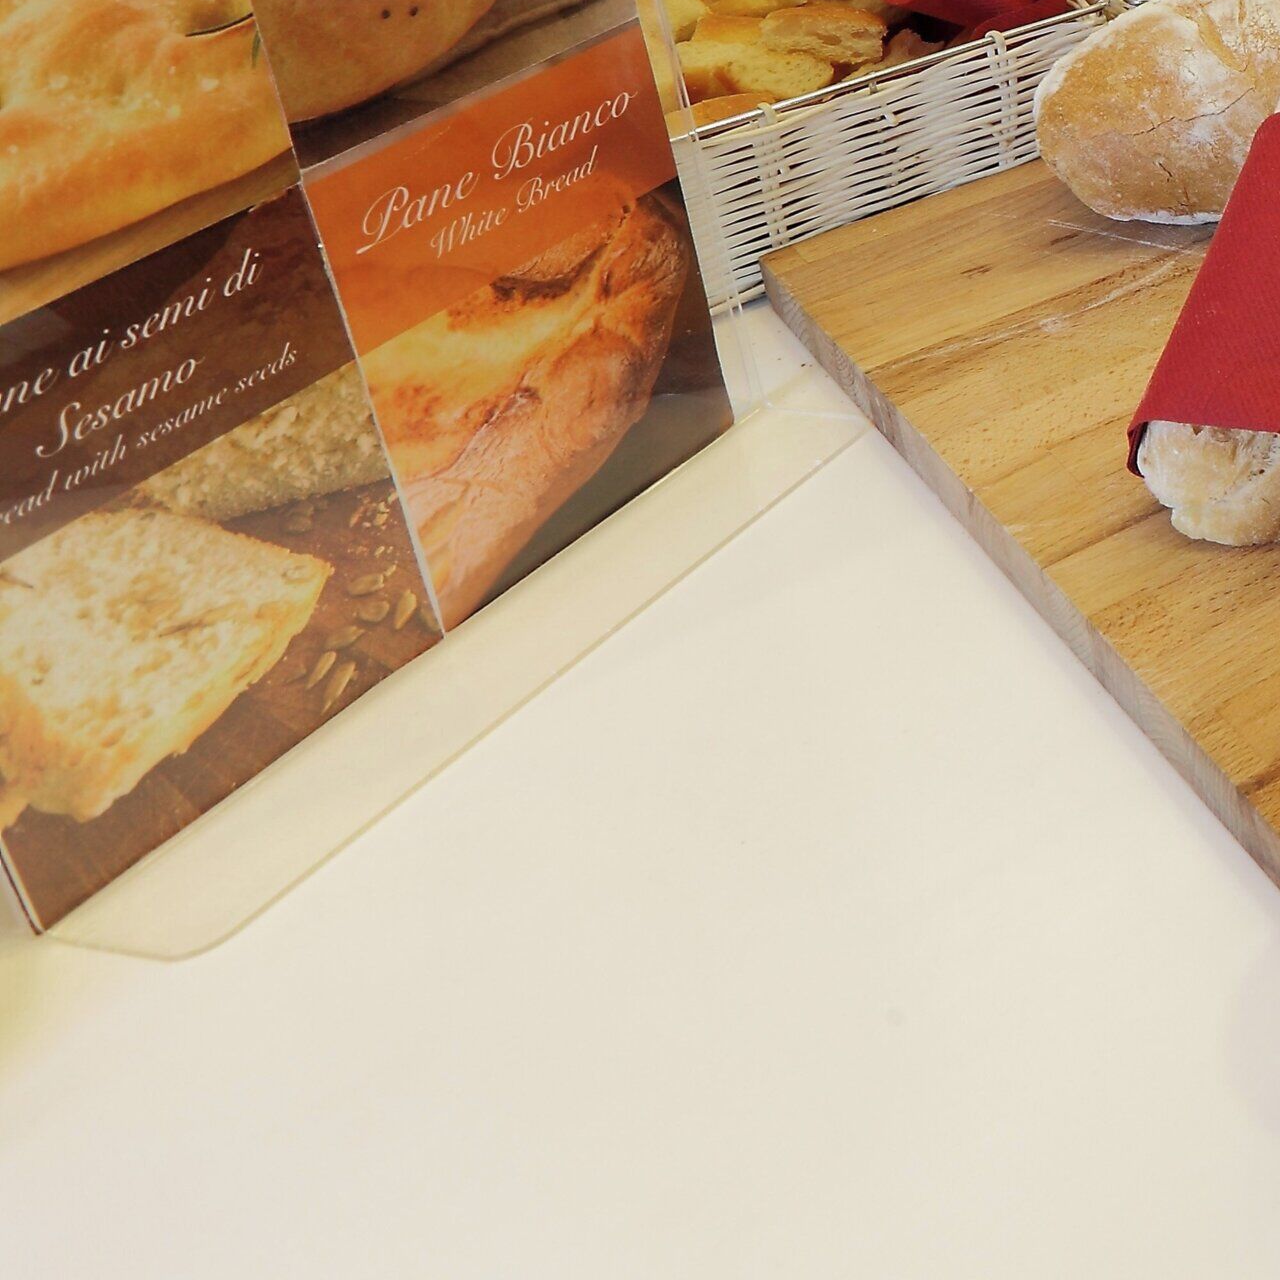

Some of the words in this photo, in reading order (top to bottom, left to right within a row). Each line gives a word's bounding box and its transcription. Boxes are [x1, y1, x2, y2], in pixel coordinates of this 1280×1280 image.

[356, 171, 480, 255] Pane
[492, 91, 638, 180] Bianco
[430, 207, 506, 258] White
[516, 145, 598, 213] Bread
[0, 368, 60, 414] ne
[68, 329, 113, 377] ai
[121, 277, 215, 349] semi
[223, 248, 263, 297] di
[35, 356, 205, 458] Sesamo
[0, 470, 58, 524] ead
[65, 433, 126, 490] with
[136, 387, 228, 448] sesame
[234, 342, 297, 393] seeds
